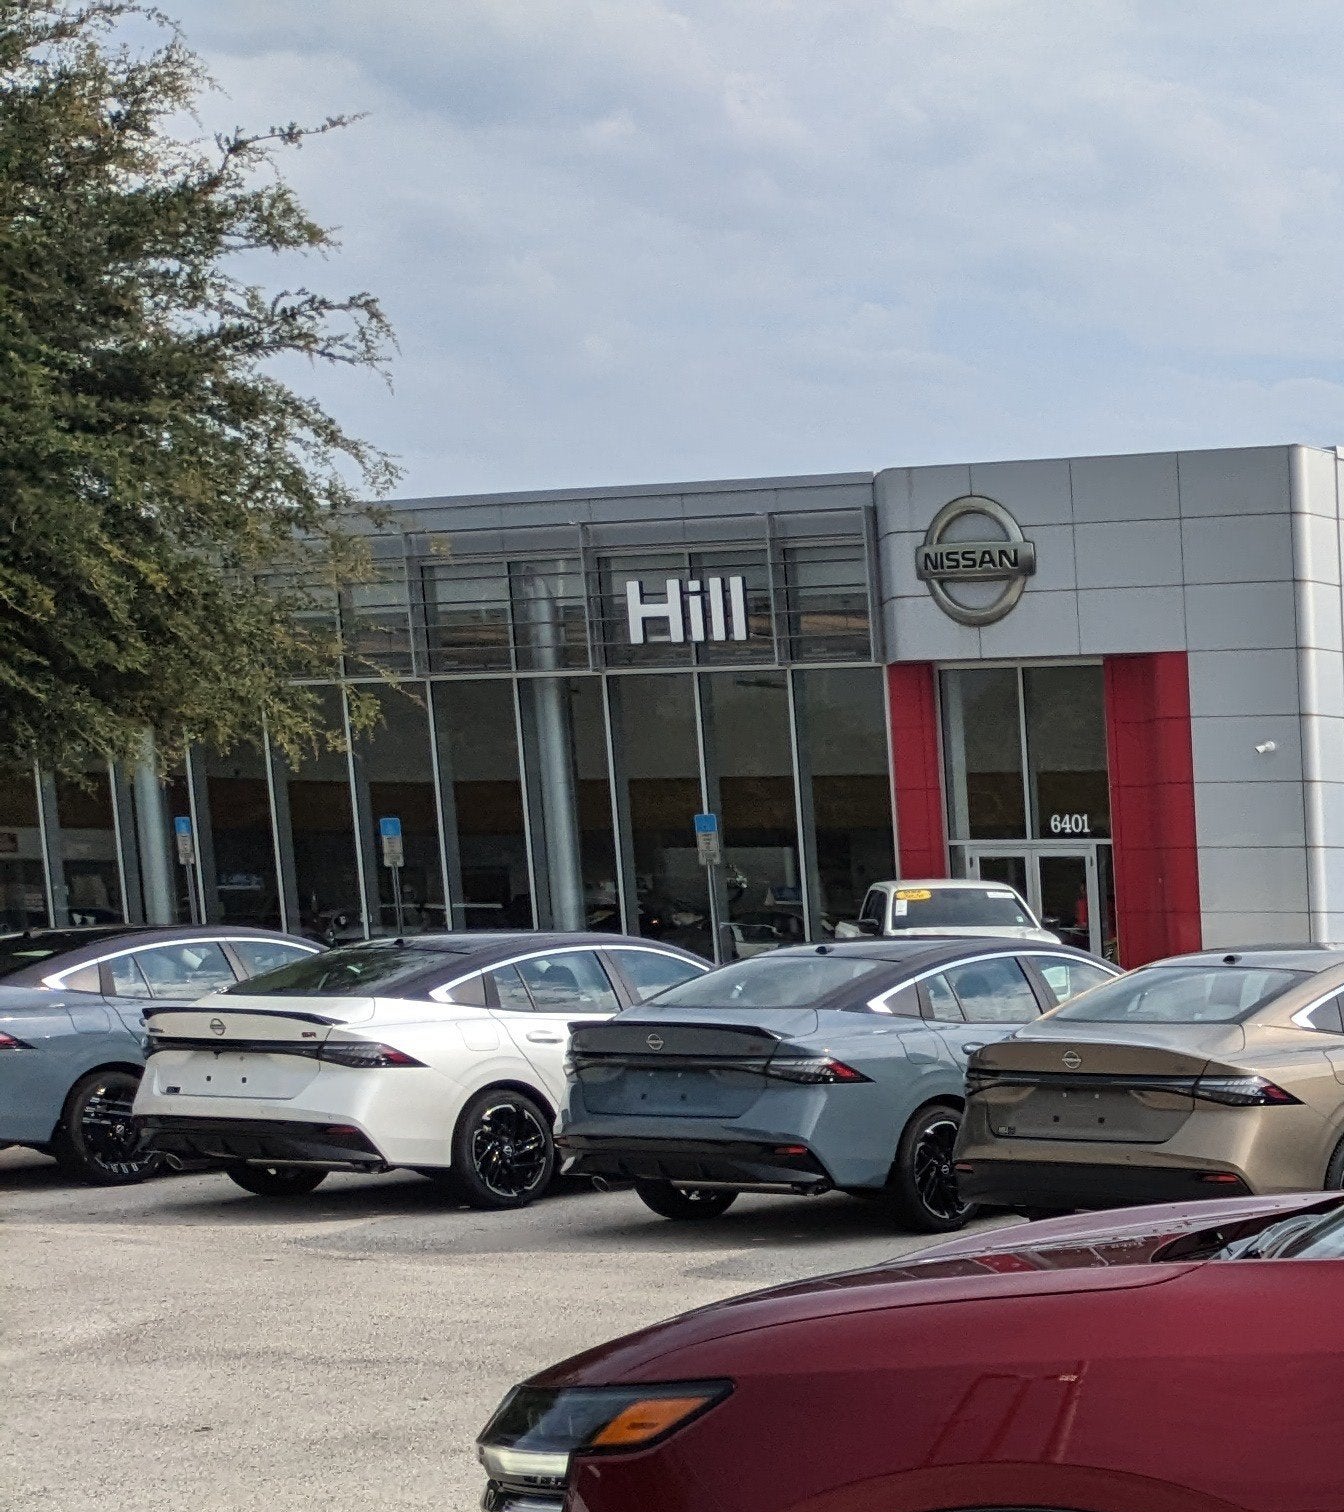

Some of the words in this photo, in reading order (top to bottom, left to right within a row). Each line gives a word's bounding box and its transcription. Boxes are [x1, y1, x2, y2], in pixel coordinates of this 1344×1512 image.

[924, 549, 1019, 571] NISSAN
[626, 576, 747, 644] Hill
[1050, 813, 1091, 833] 6401
